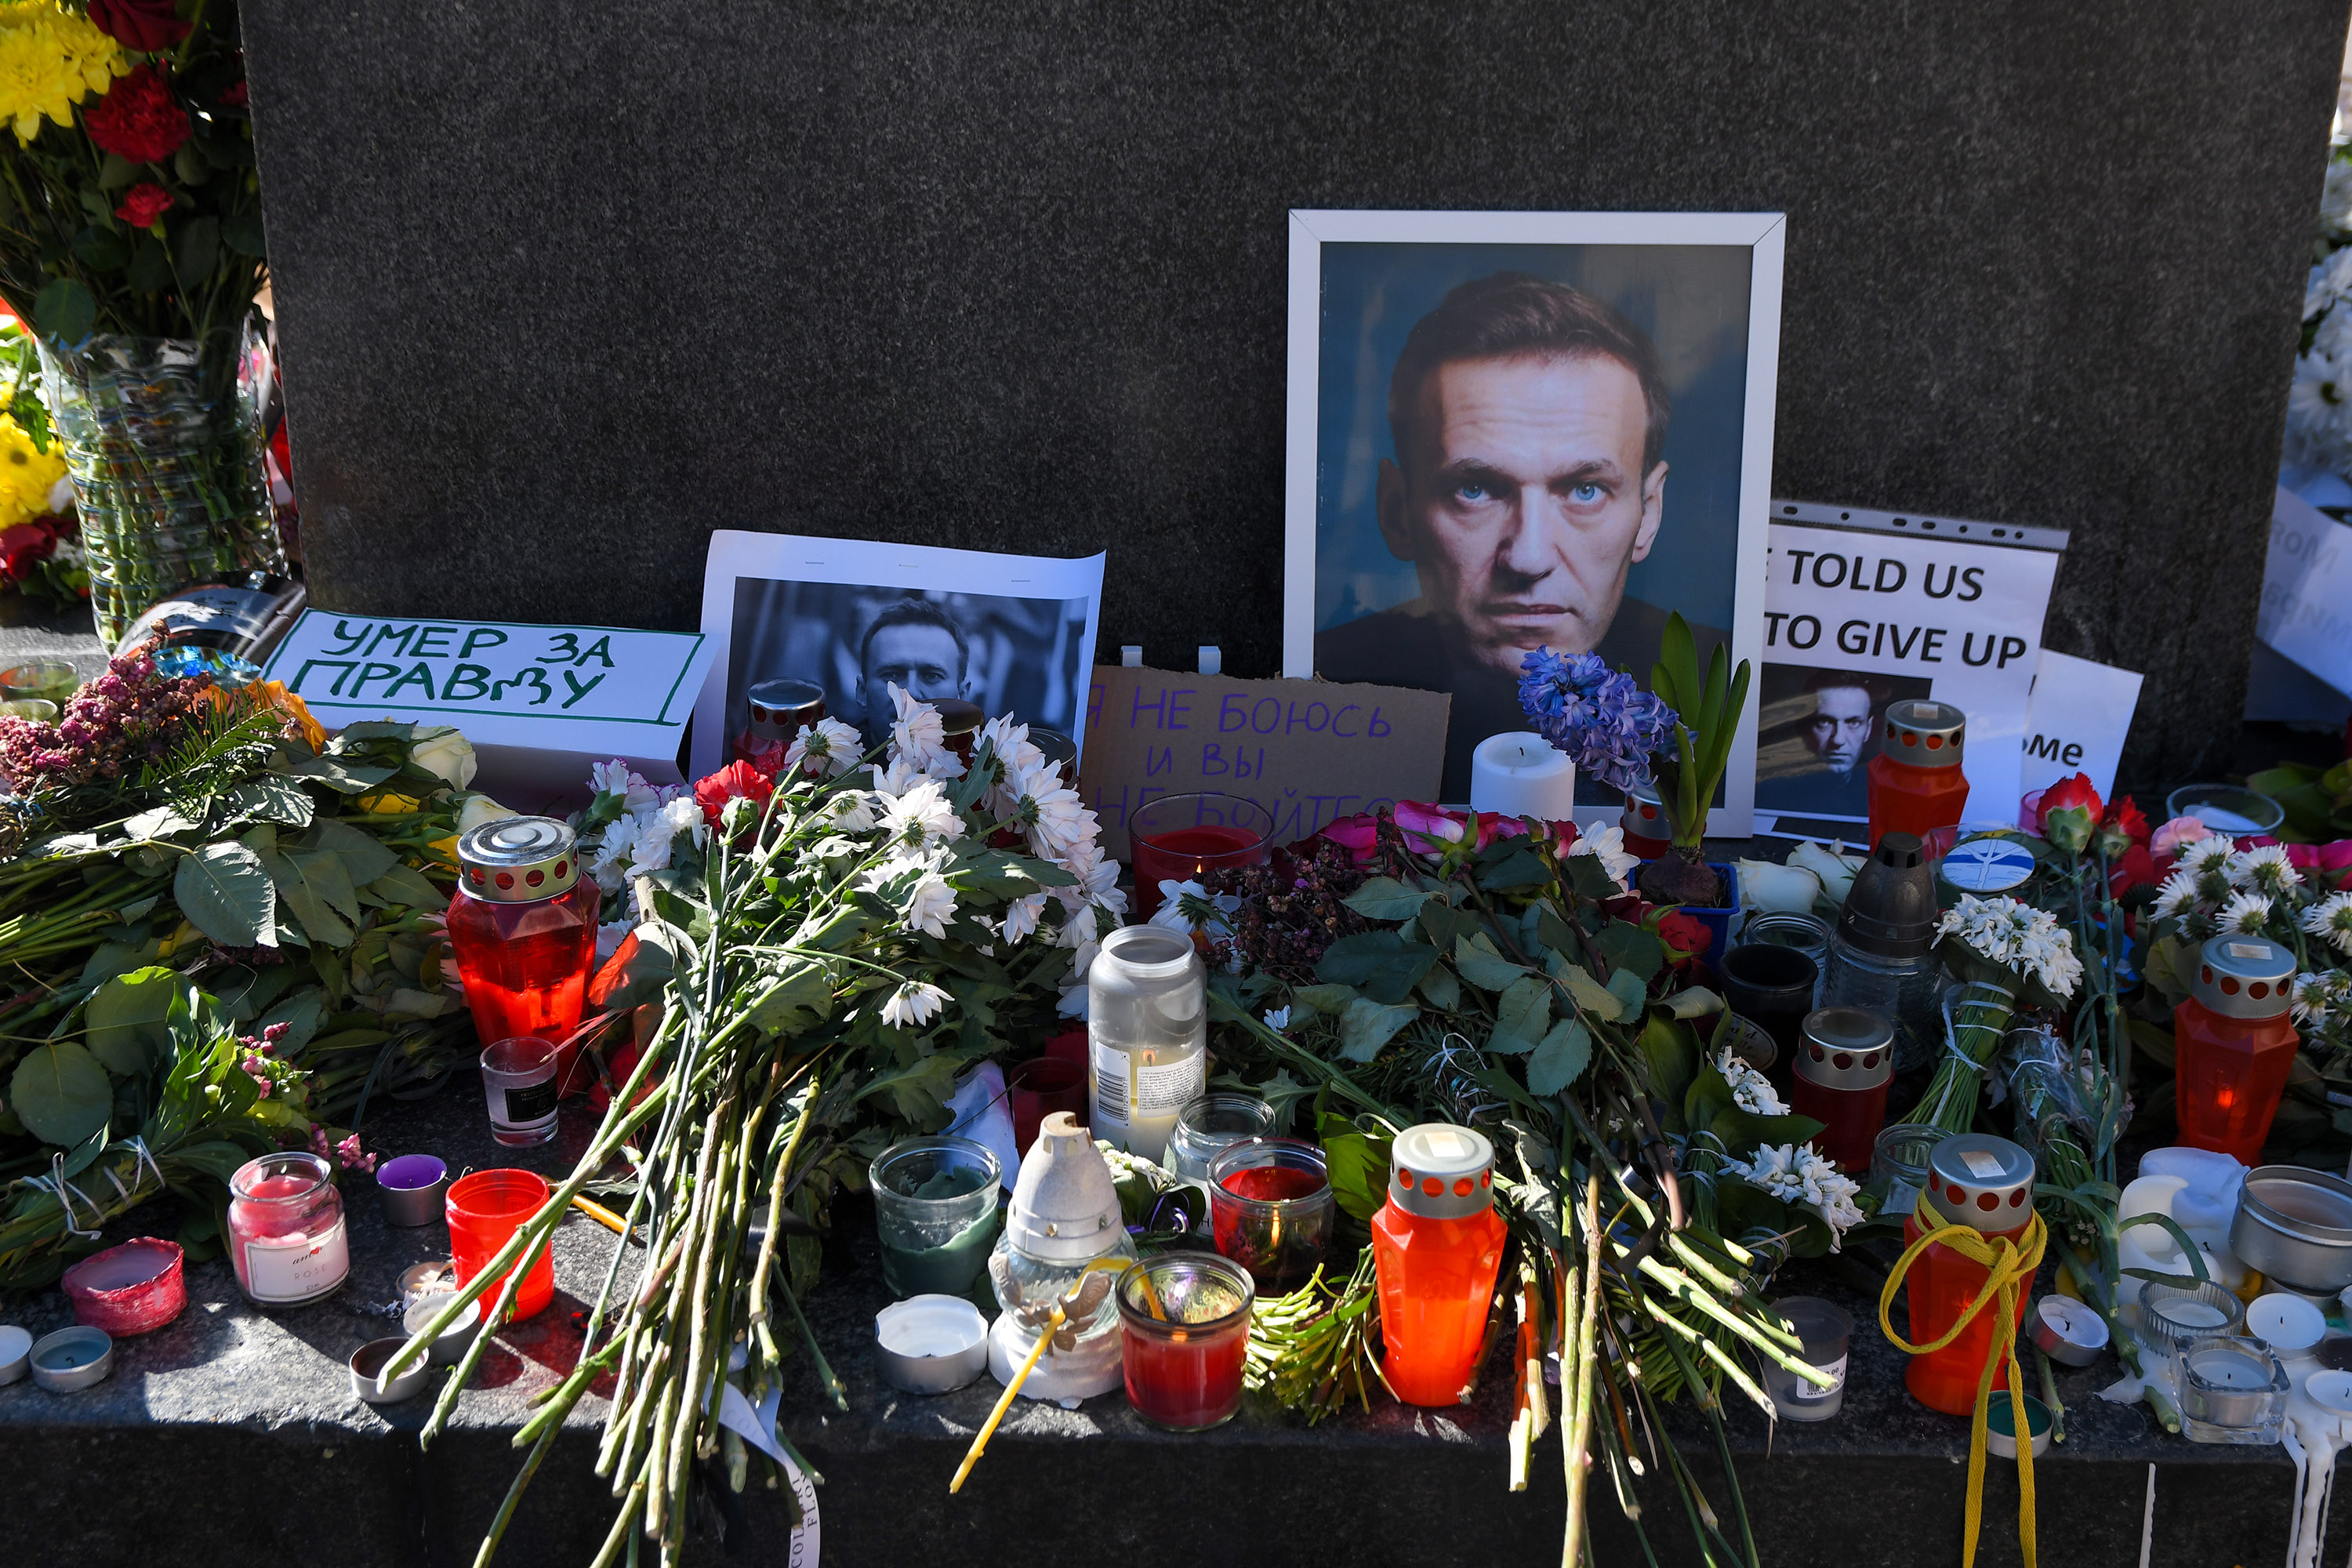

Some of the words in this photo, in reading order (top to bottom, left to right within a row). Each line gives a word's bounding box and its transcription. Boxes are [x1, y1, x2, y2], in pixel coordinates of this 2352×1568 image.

[1787, 549, 1907, 593] TOLD
[1924, 563, 1985, 601] US
[321, 619, 509, 659] УМЕР
[535, 632, 616, 668] ЗА
[1763, 611, 1821, 649] TO
[1837, 620, 1947, 662] GIVE
[1962, 631, 2027, 669] UP
[1131, 685, 1196, 730] НЕ
[1218, 693, 1392, 738] БОЮСЬ
[1146, 745, 1171, 777] И
[1202, 742, 1265, 781] ВЫ
[2023, 734, 2083, 767] ме
[1095, 785, 1166, 828] НЕ
[294, 1264, 327, 1279] ROSE
